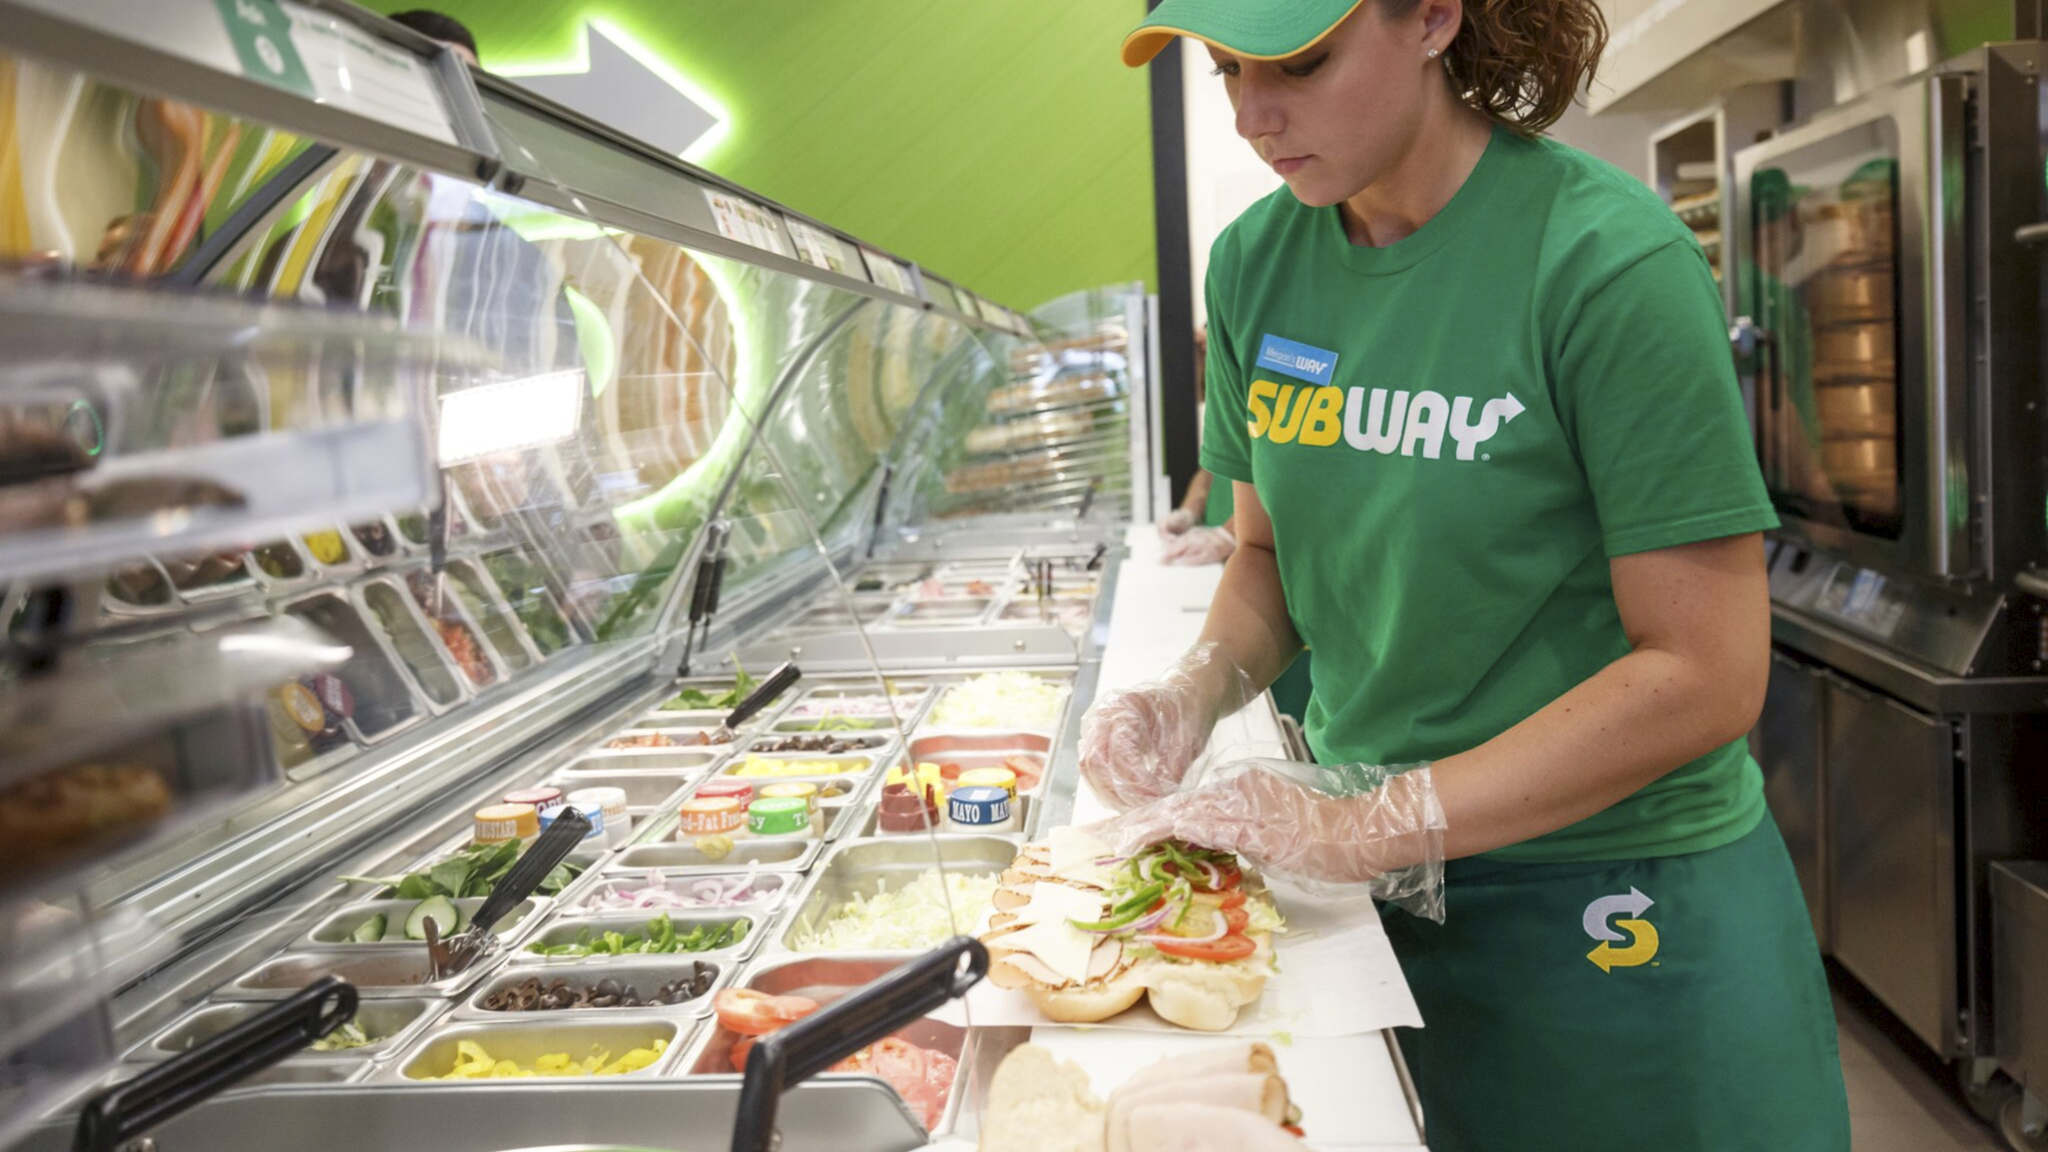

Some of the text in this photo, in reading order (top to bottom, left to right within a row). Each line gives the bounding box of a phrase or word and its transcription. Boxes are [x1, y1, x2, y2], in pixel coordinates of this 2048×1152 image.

[1296, 355, 1329, 375] WAY
[1247, 379, 1526, 461] SUBWAY
[952, 800, 980, 823] MAYO
